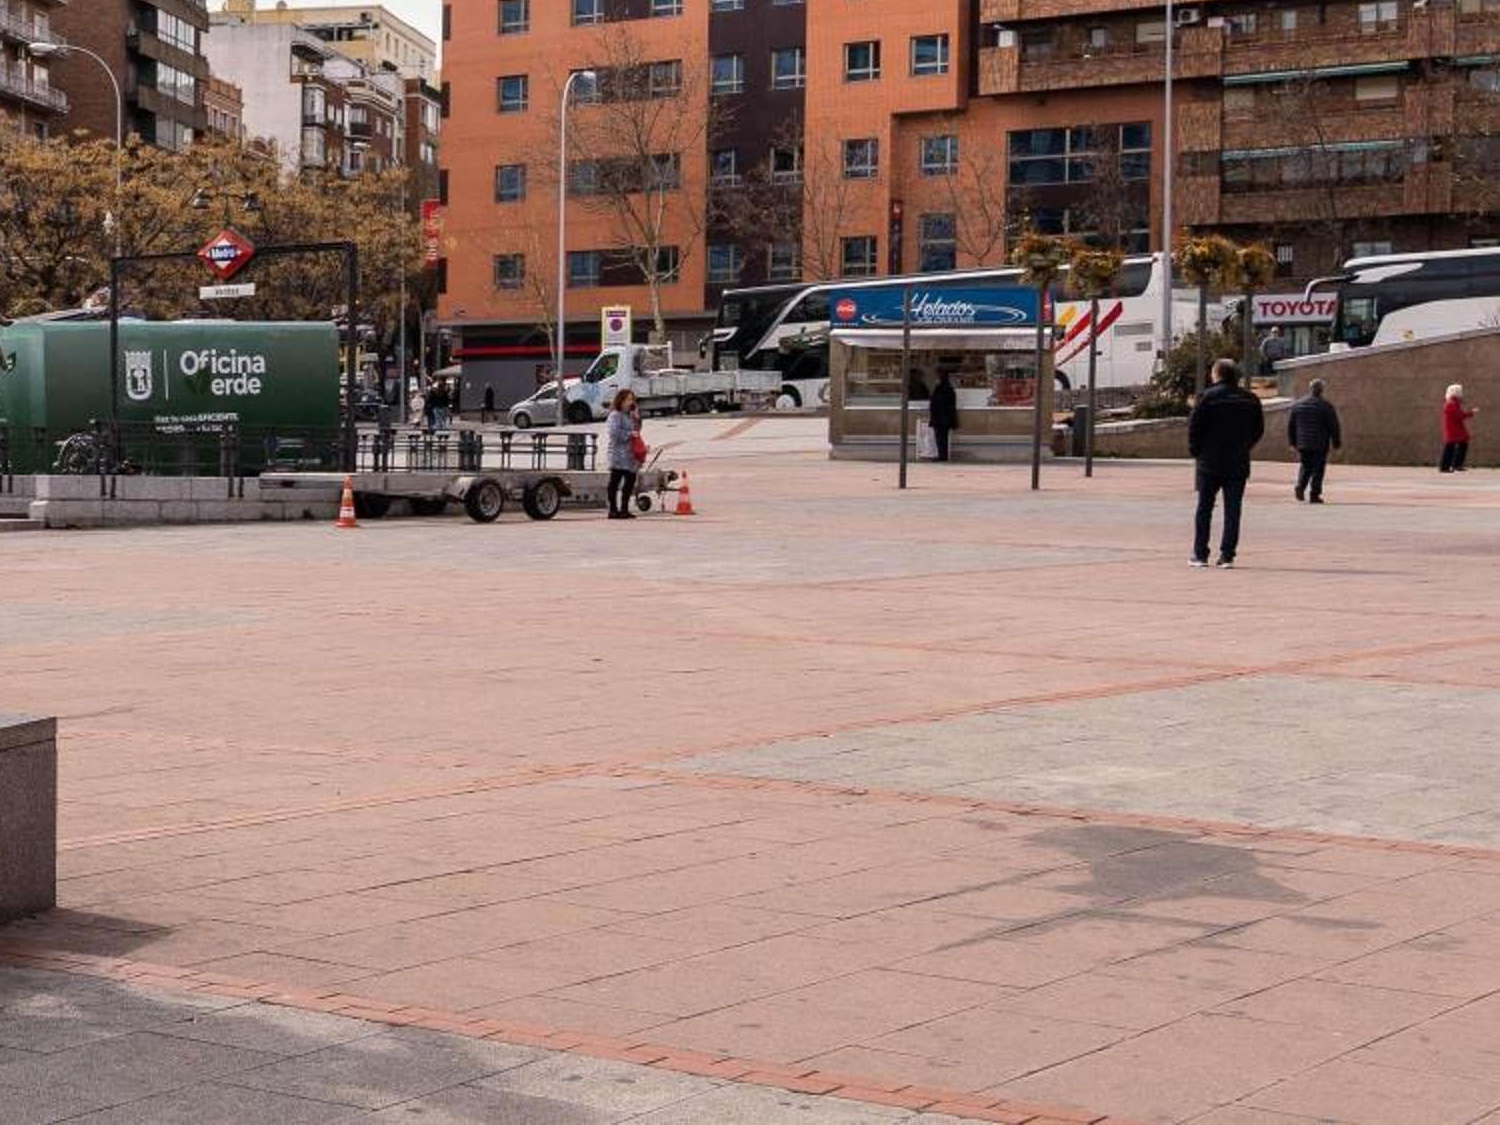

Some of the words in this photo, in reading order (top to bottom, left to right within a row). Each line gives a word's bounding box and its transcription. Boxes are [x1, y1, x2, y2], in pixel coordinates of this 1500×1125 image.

[211, 247, 235, 259] Metro
[910, 292, 976, 317] Helados
[179, 349, 266, 375] Oficina
